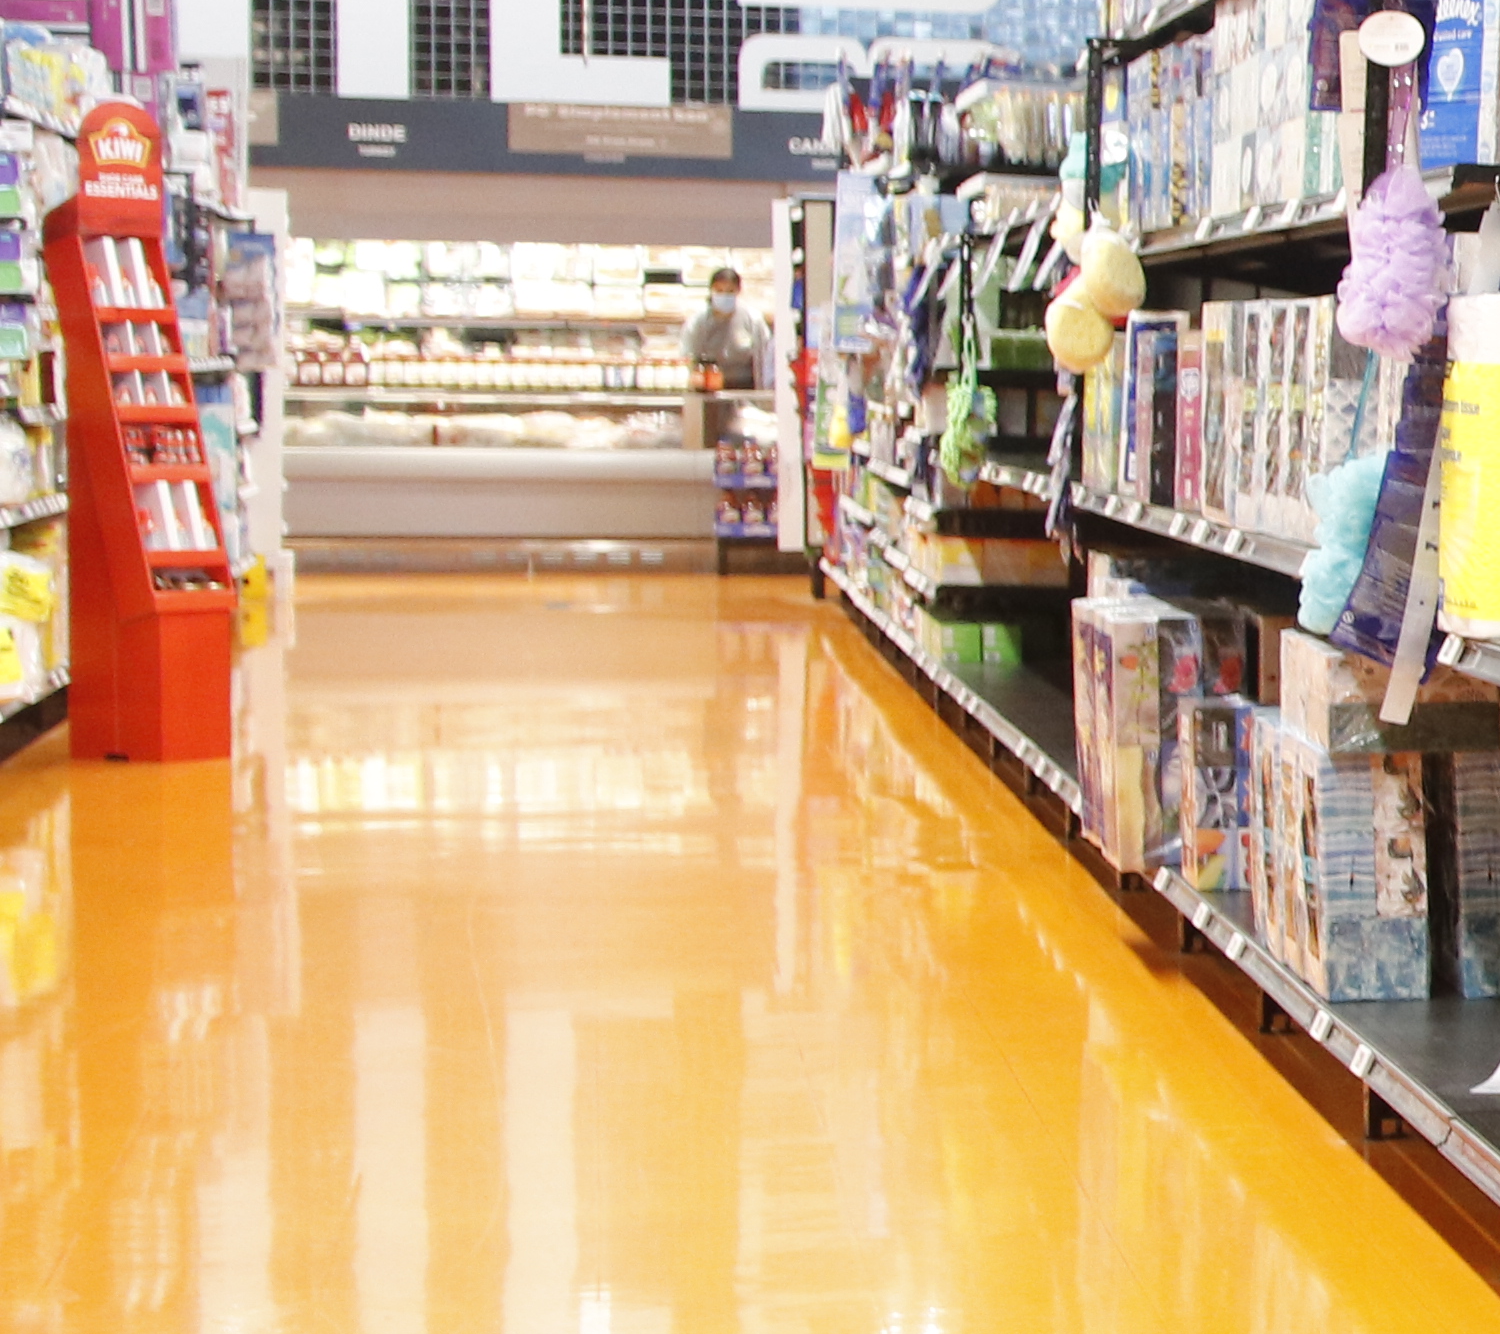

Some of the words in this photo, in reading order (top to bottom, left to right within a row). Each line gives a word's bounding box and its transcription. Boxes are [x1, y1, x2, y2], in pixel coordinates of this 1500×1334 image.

[348, 123, 406, 143] DINDE
[97, 136, 143, 163] KIWI
[85, 180, 159, 201] ESSENTIALS
